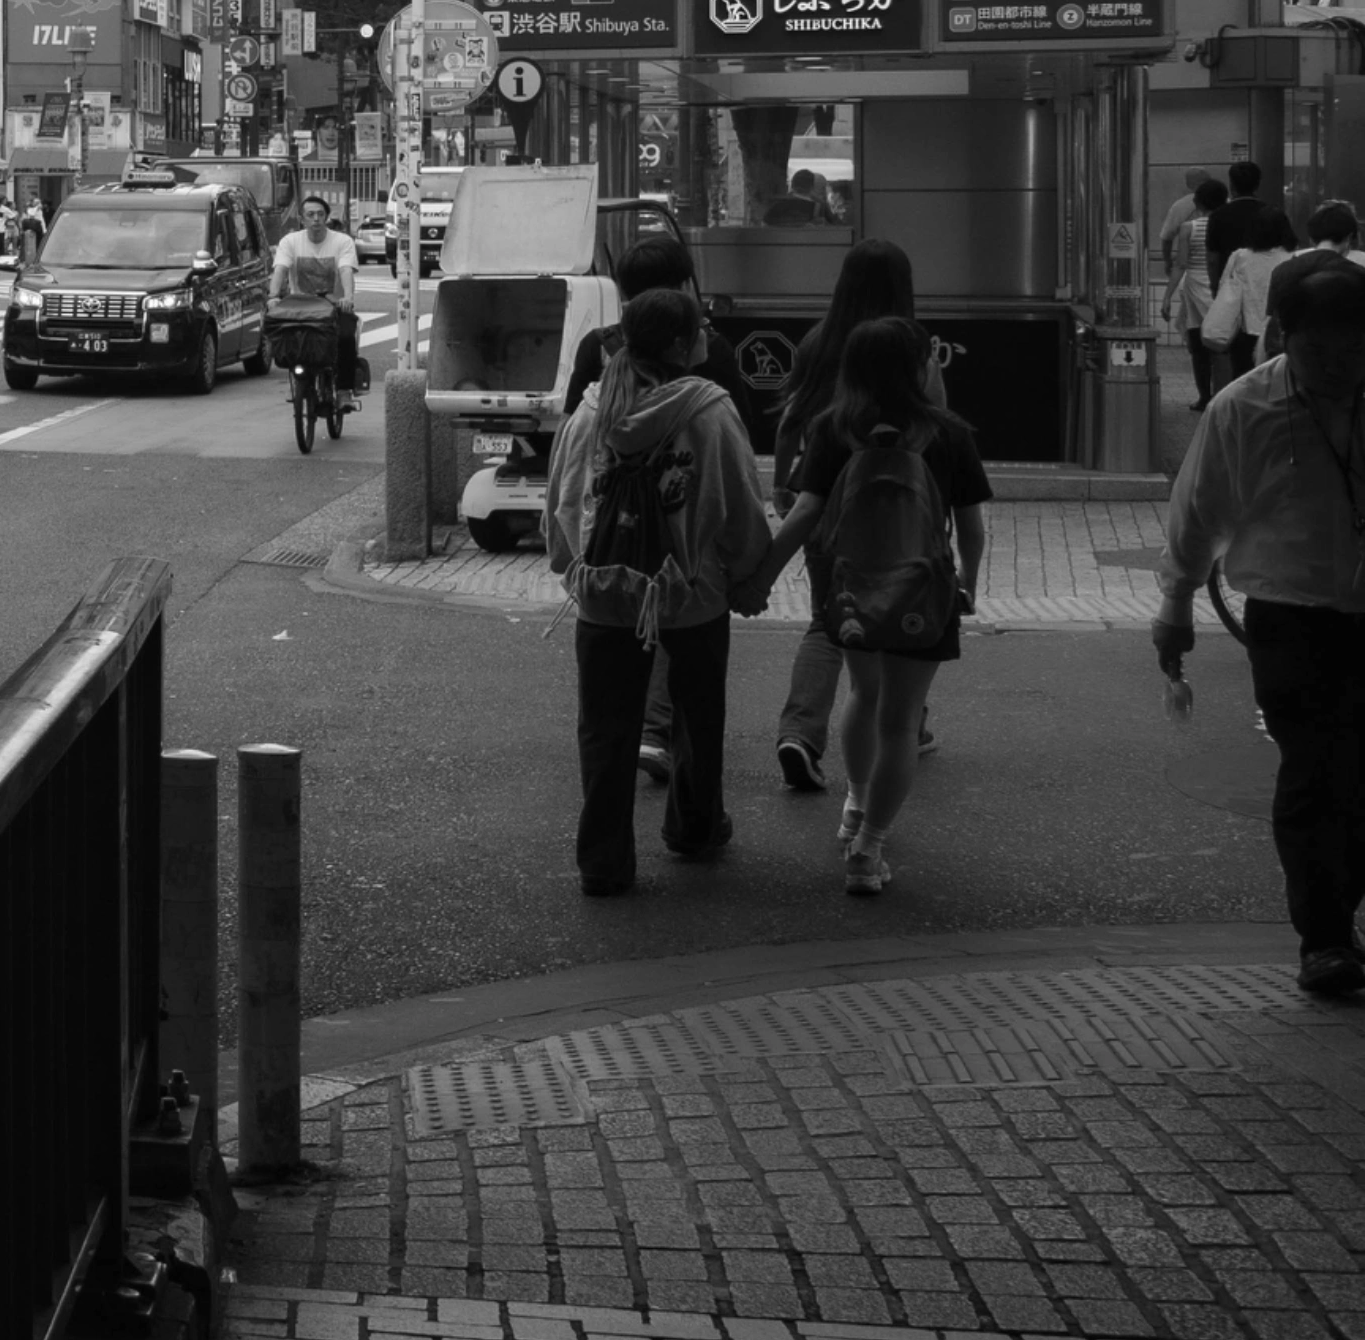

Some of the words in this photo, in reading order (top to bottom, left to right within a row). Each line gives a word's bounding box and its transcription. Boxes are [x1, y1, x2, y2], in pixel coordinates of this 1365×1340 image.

[978, 5, 1048, 20] 田園都市線
[1086, 3, 1143, 17] 半蔵門線
[513, 12, 582, 35] 渋谷駅
[585, 18, 640, 36] Shibuya
[643, 17, 670, 32] Sta.
[785, 17, 882, 32] SHIBUCHIKA
[954, 14, 972, 26] DT
[977, 20, 1032, 30] Den-en-toshi
[1034, 19, 1052, 29] Line
[1086, 17, 1133, 27] Hanzomon
[1134, 17, 1153, 27] Line
[33, 25, 97, 46] 17LIE
